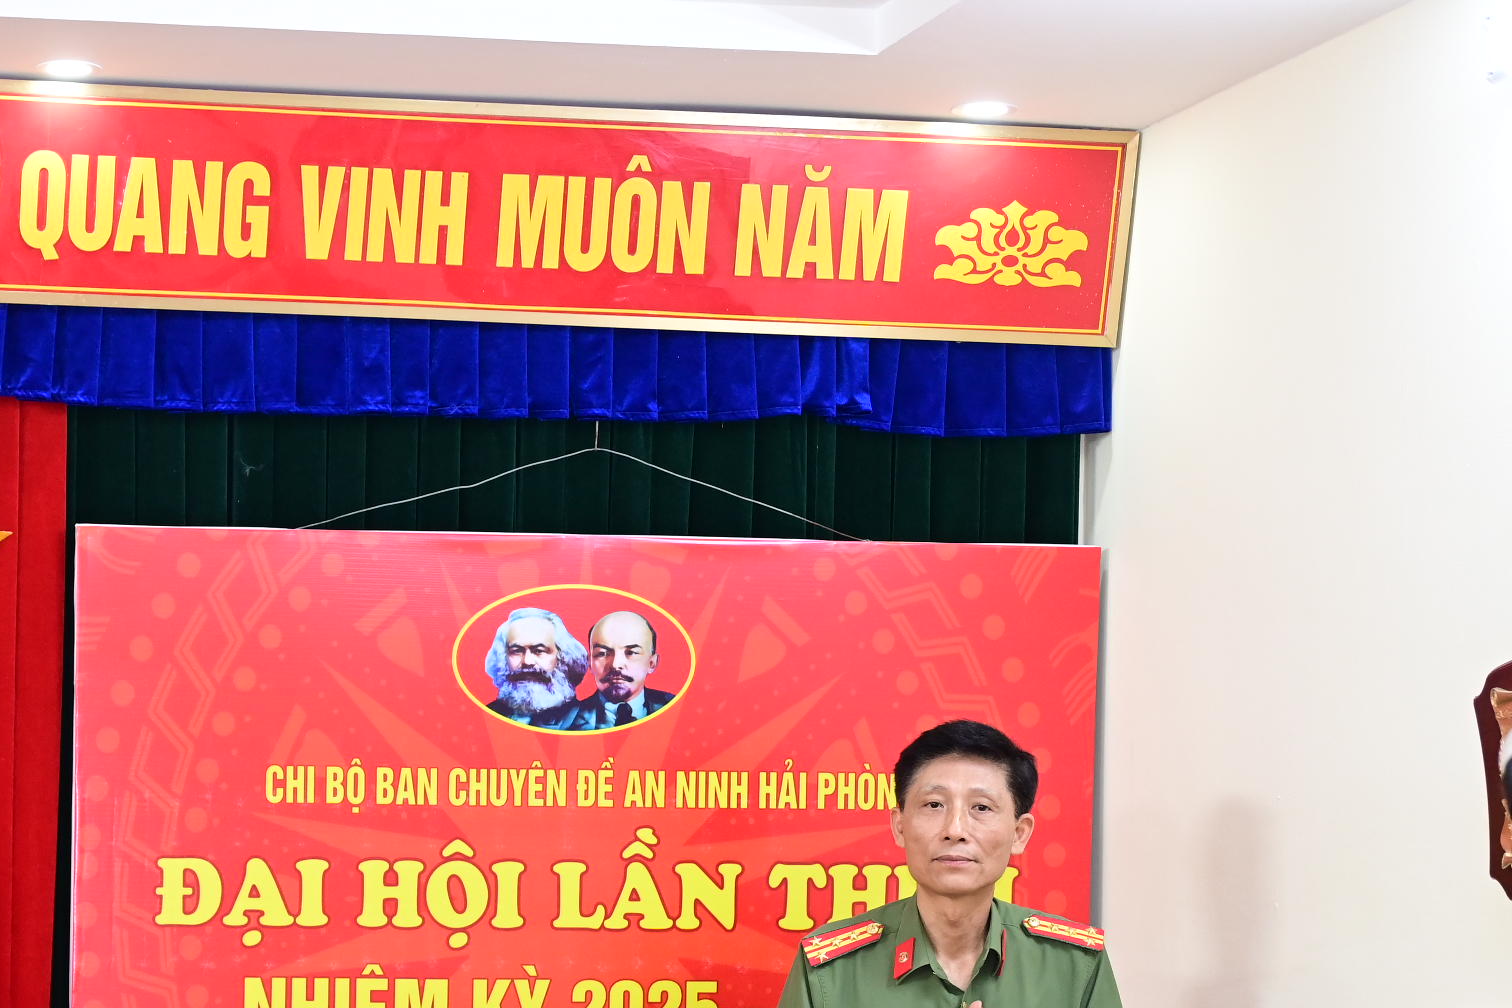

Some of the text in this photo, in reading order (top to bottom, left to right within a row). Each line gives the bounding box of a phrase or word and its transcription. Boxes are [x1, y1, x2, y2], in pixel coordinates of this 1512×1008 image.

[20, 150, 271, 261] QUANG
[300, 165, 469, 266] VINH
[495, 155, 711, 275] MUÔN
[734, 164, 911, 283] NĂM
[265, 756, 897, 814] CHI BỘ BAN CHUYÊN ĐỀ AN NINH HẢI PHÒN
[154, 857, 330, 947] ĐẠI
[356, 839, 525, 949] HỘI
[552, 827, 743, 930] LẦN
[768, 863, 917, 931] TH
